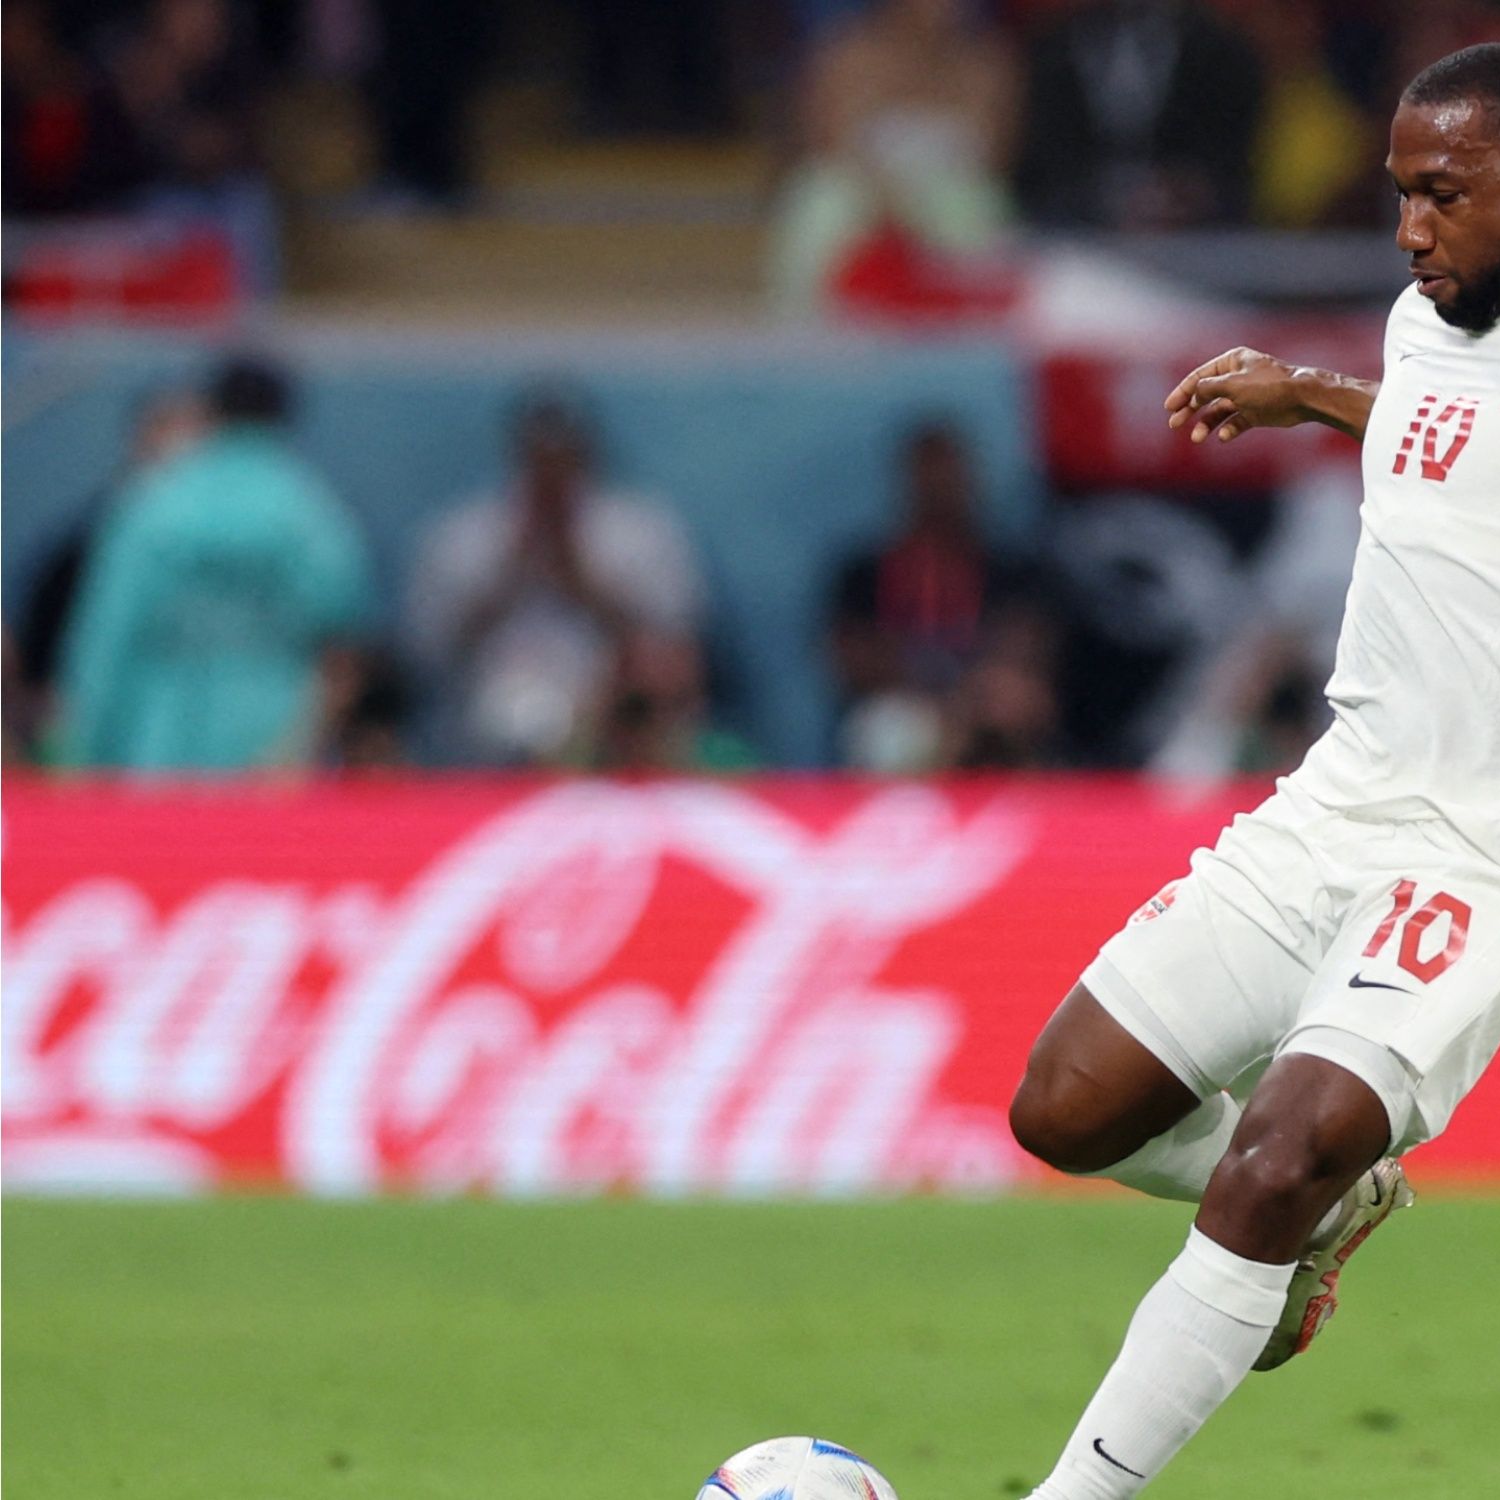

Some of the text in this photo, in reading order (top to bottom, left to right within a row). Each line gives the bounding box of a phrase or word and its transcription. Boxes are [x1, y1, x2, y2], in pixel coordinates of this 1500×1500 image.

[1391, 393, 1480, 483] 10
[1361, 878, 1473, 985] 10
[0, 782, 1045, 1198] ca-Cola
